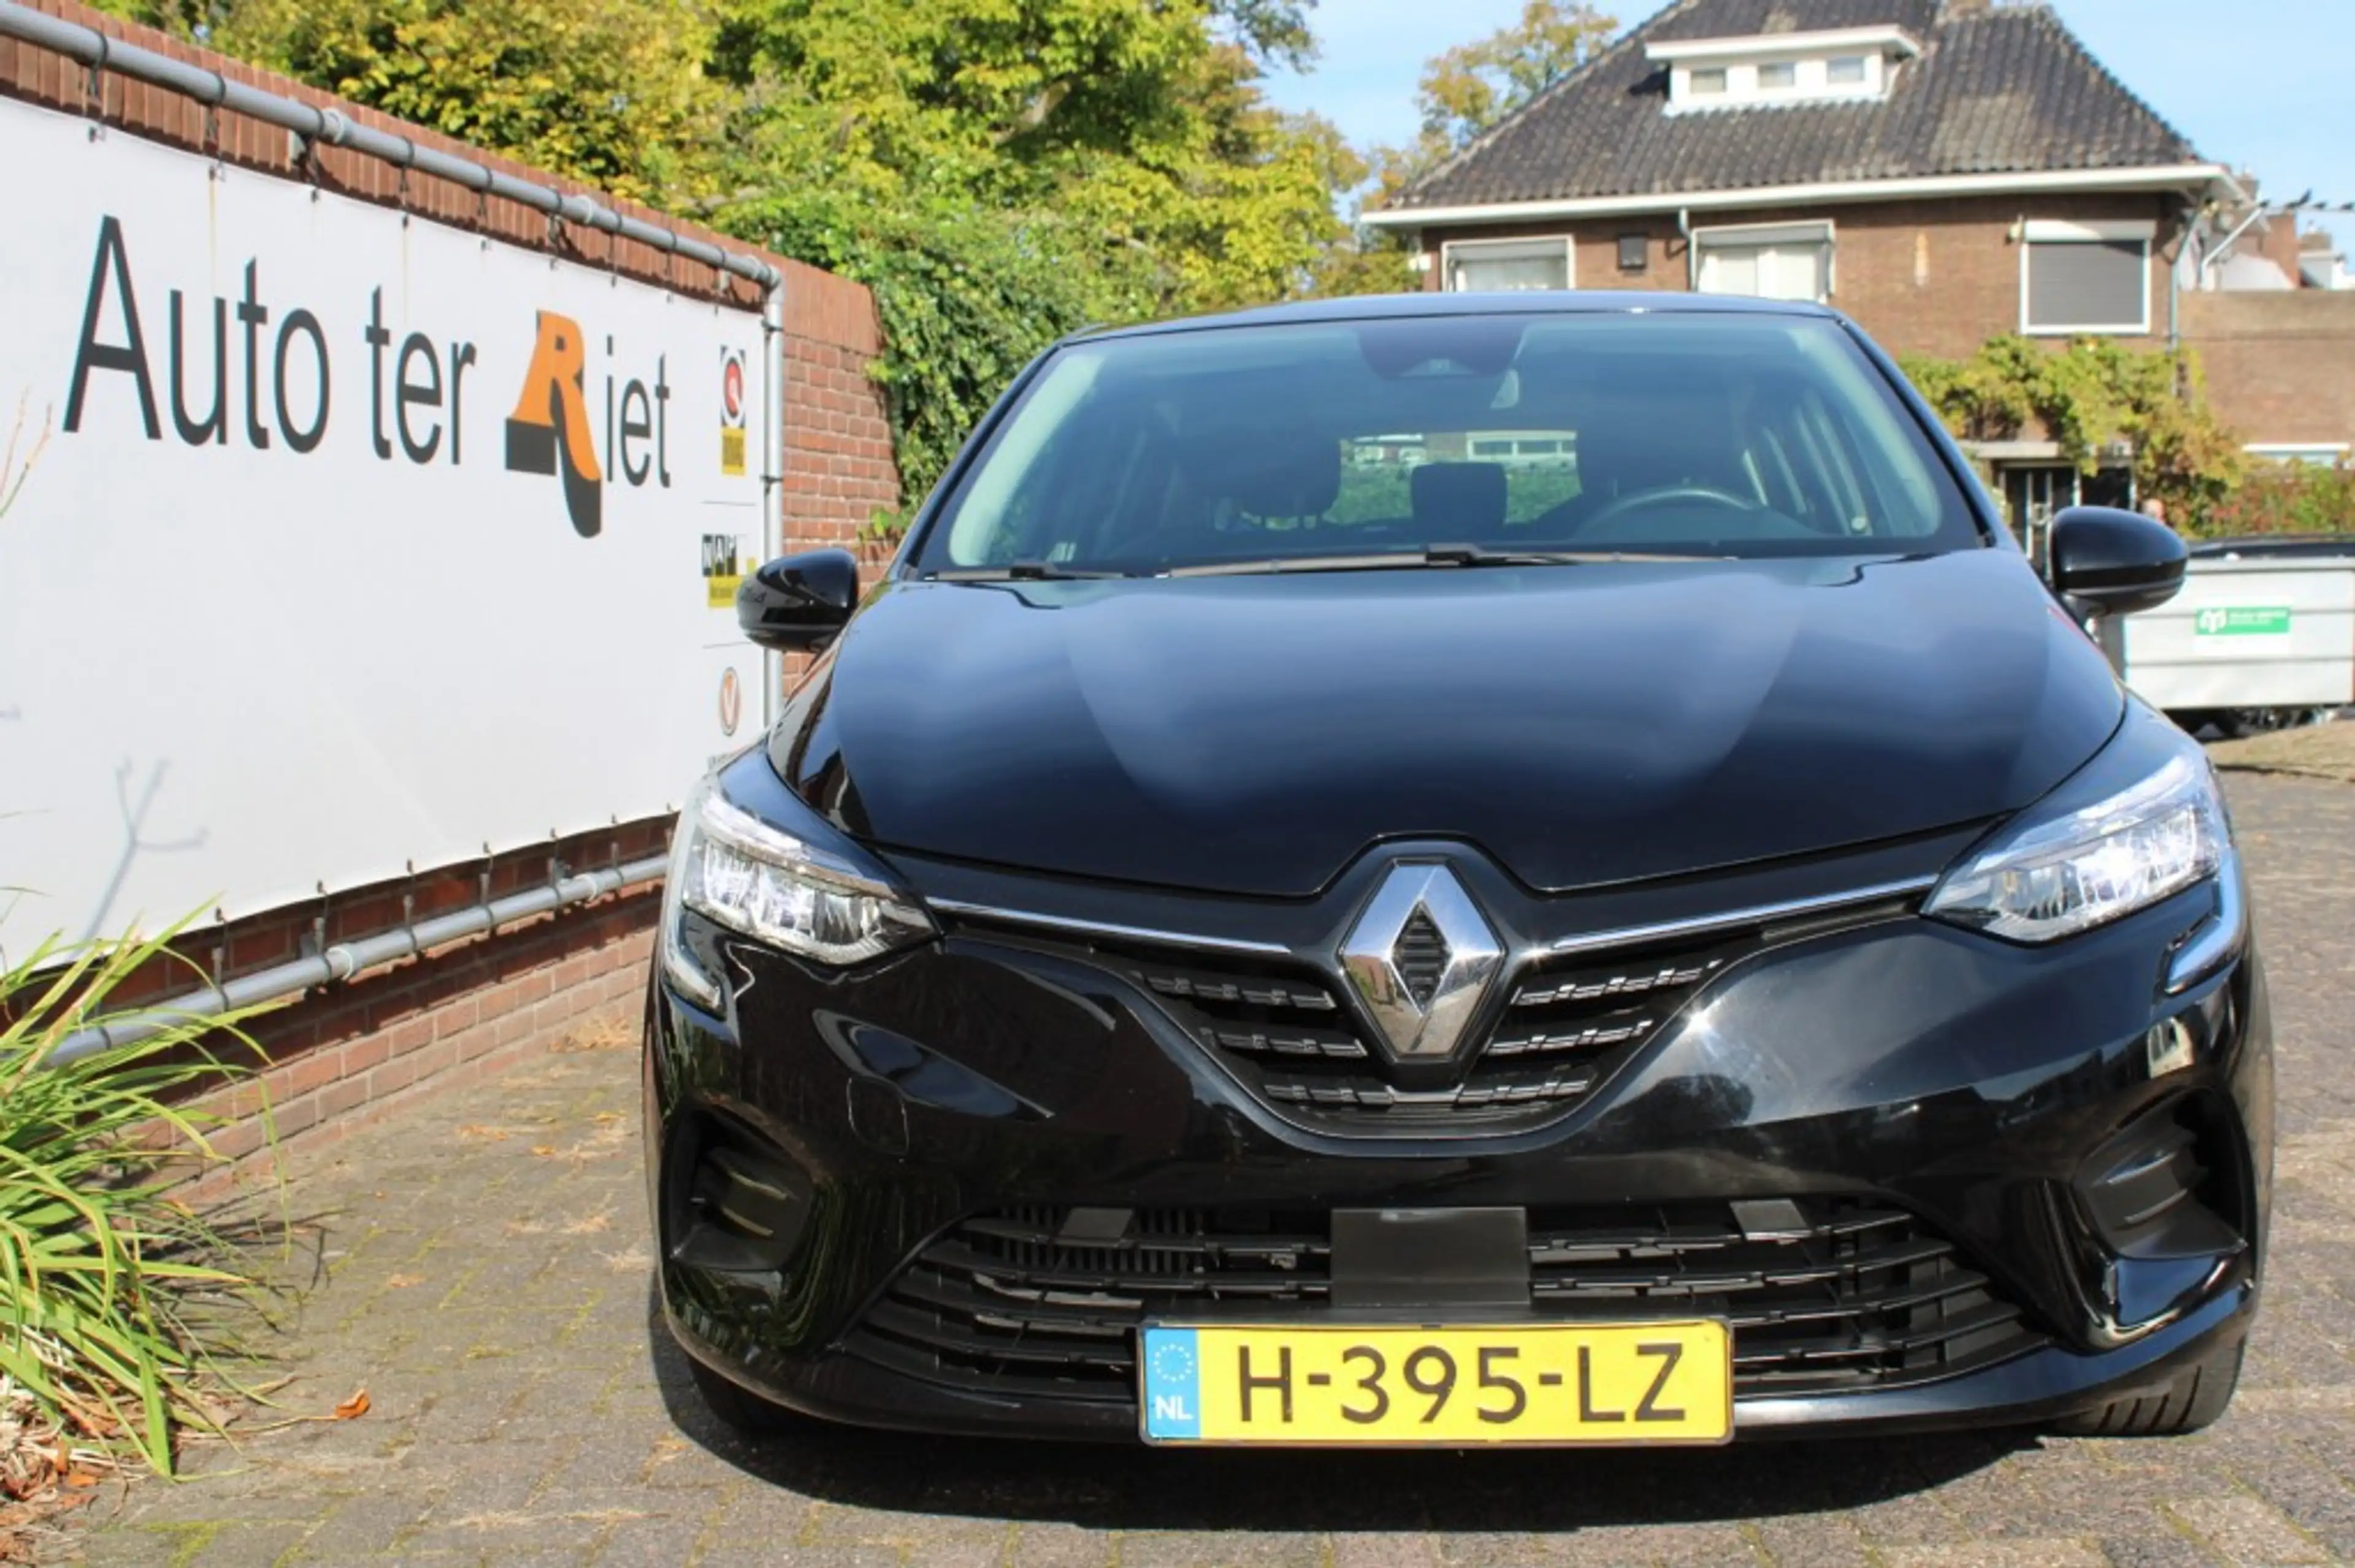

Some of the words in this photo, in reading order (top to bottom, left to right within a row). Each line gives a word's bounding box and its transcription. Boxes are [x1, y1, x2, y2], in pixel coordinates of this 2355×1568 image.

[63, 215, 330, 454] Auto
[365, 286, 477, 465] ter
[504, 309, 670, 539] Riet
[1155, 1395, 1193, 1420] NL
[1238, 1342, 1686, 1424] H-395-LZ
